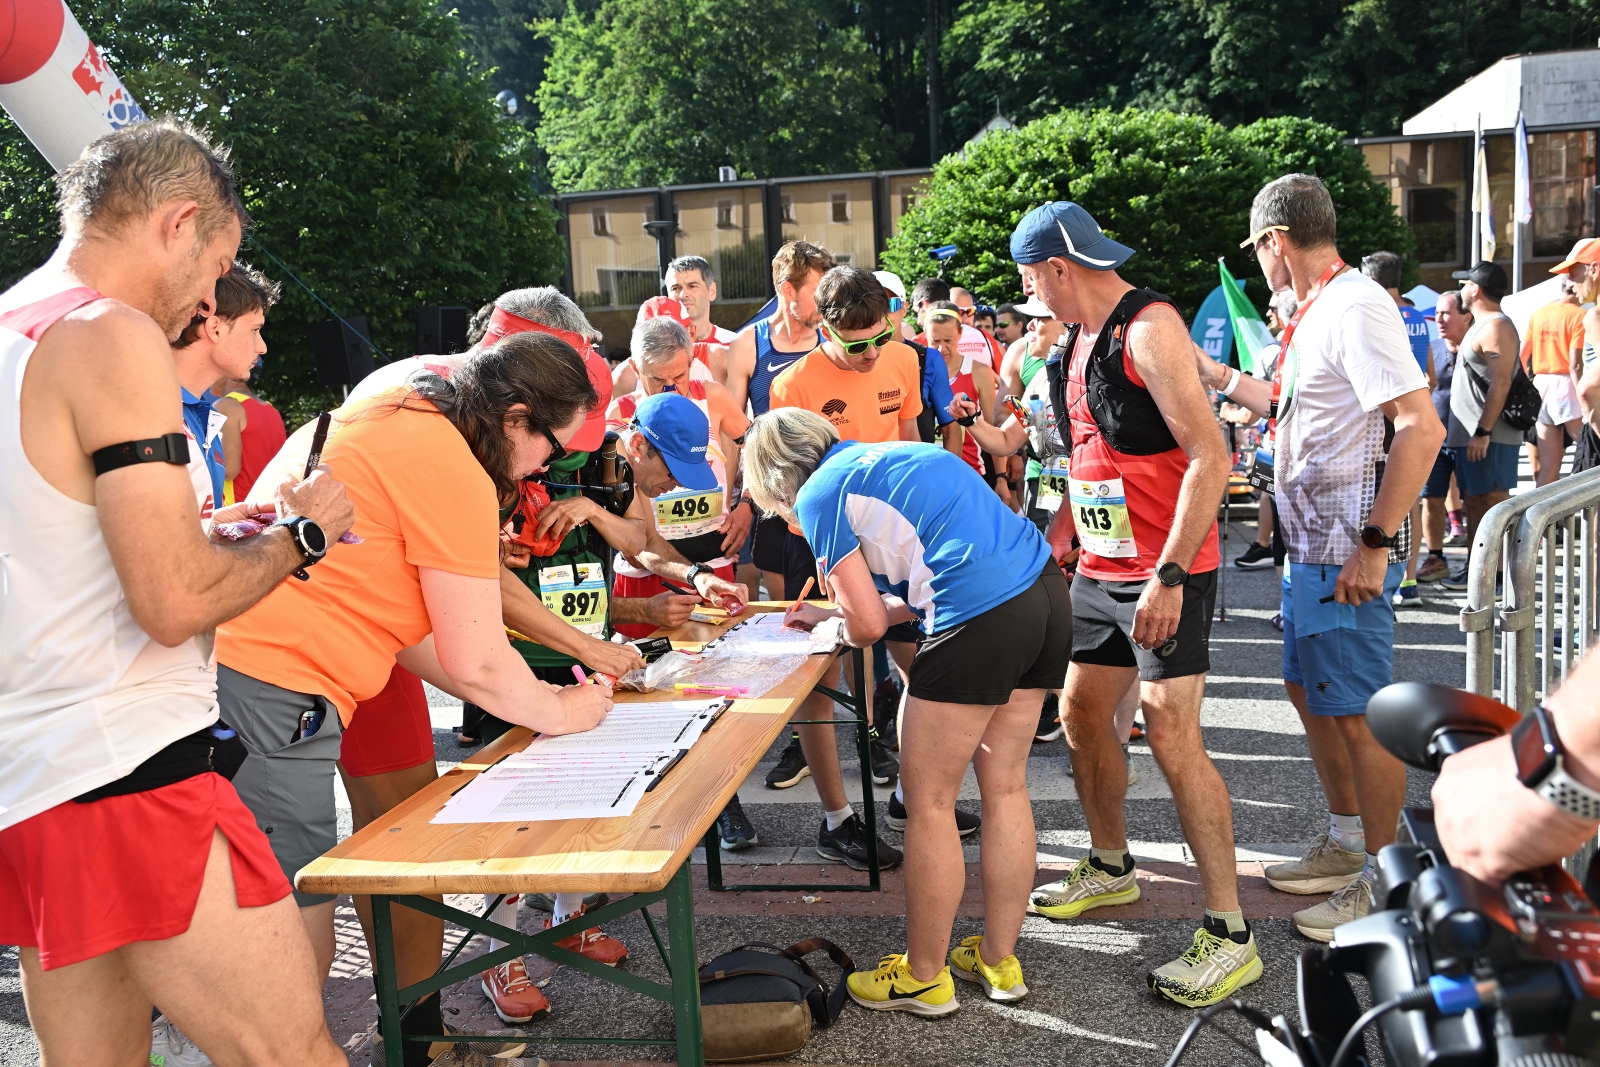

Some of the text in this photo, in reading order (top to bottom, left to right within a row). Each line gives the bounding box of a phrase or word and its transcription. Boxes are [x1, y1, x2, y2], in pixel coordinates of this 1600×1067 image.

[1203, 318, 1226, 363] EN
[1406, 323, 1427, 336] ALIA
[1050, 476, 1068, 494] 43
[672, 497, 710, 518] 496
[1080, 506, 1112, 530] 413
[562, 592, 599, 616] 897
